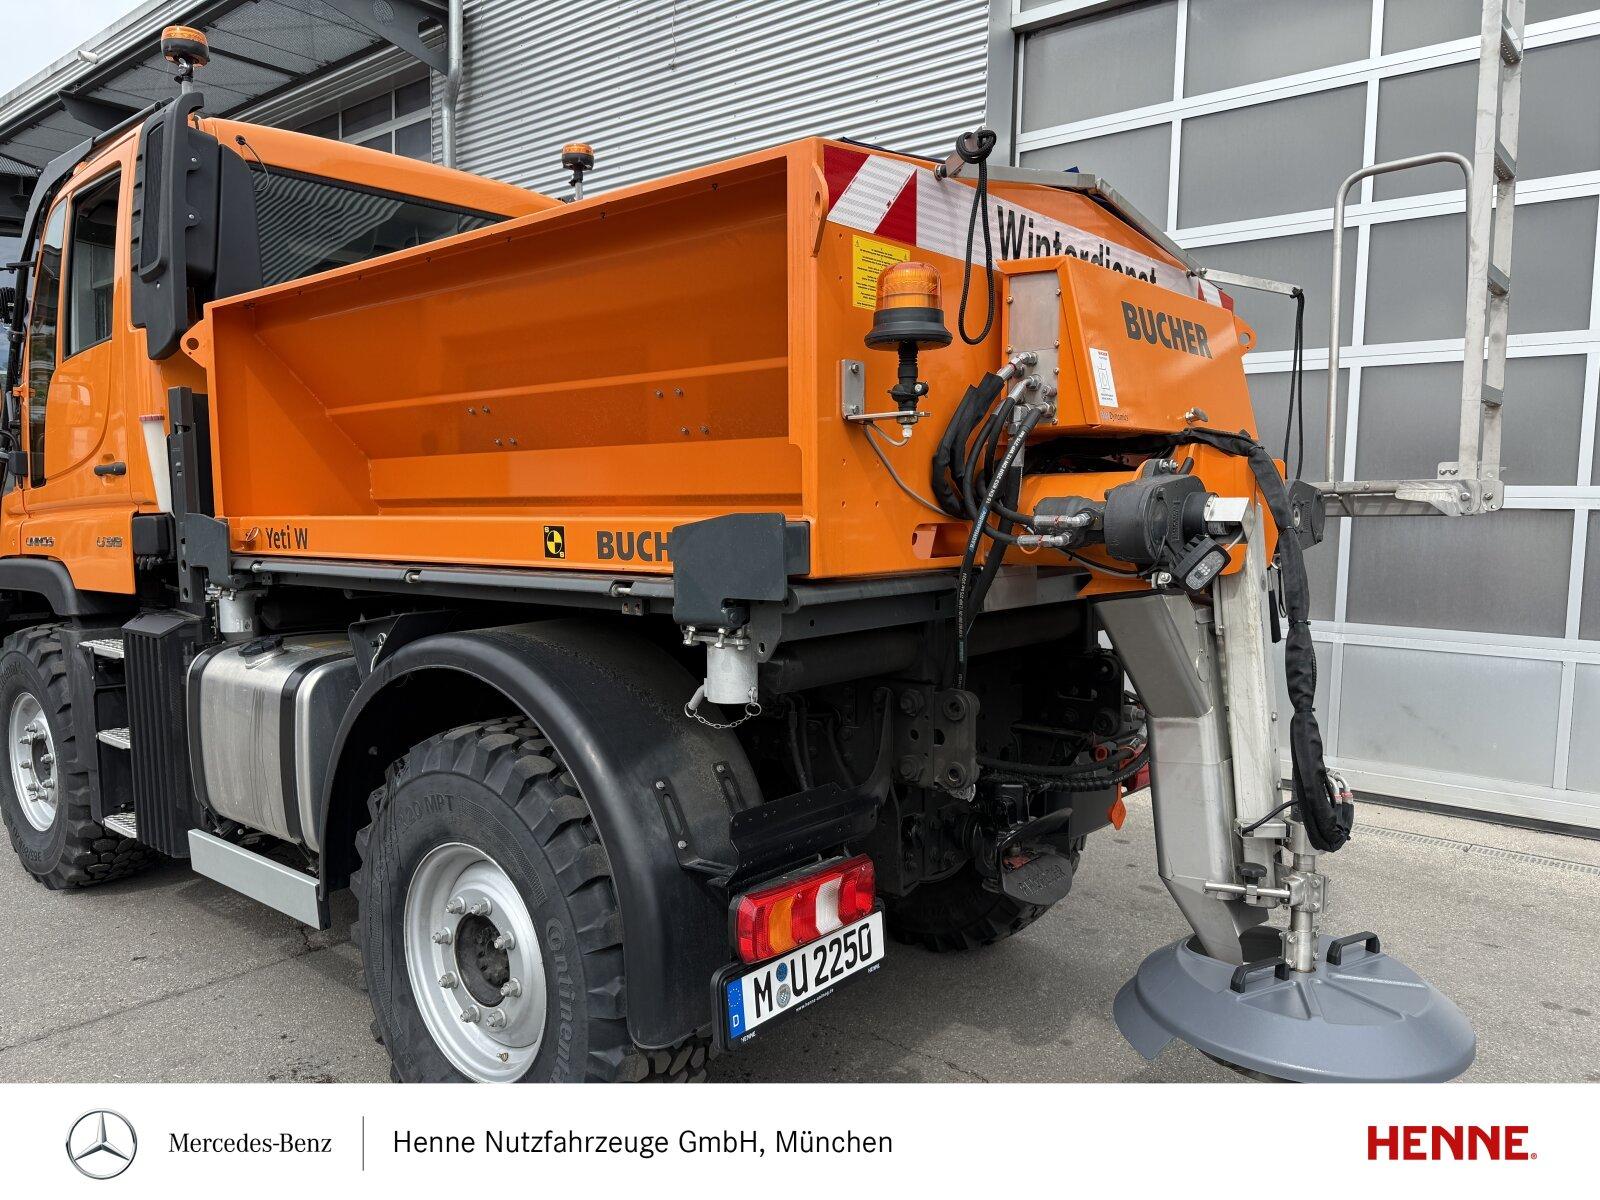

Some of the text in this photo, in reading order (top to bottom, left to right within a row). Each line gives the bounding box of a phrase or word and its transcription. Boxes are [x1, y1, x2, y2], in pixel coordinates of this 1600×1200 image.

[1121, 301, 1213, 359] BUCHER
[265, 525, 308, 549] Yeti W
[753, 922, 872, 1019] M U 2250
[732, 1014, 740, 1028] D
